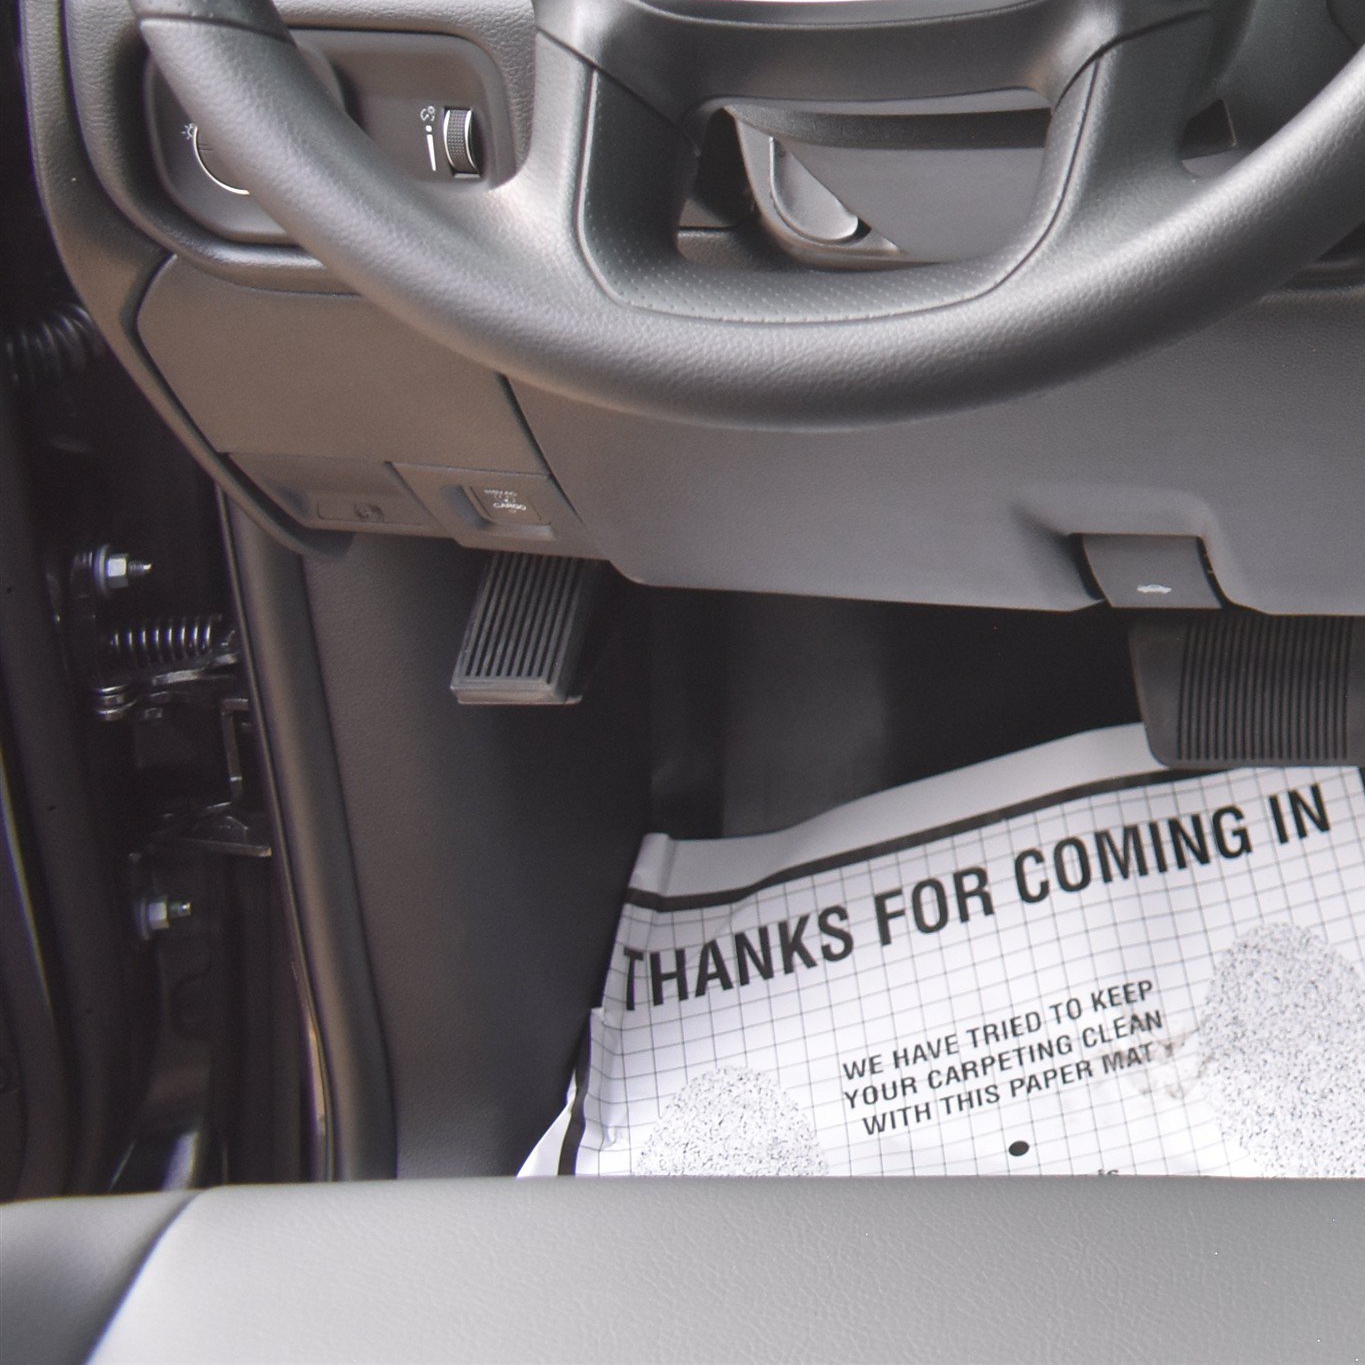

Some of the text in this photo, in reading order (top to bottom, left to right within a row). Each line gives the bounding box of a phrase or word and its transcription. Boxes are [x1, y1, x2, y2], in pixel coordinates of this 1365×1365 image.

[623, 783, 1331, 1012] THANKS FOR COMING IN
[842, 979, 1154, 1081] WE HAVE TRIED TO KEEP
[844, 1009, 1164, 1110] YOUR CARPETING CLEAN
[862, 1041, 1154, 1136] WITH THIS PAPER MAT
